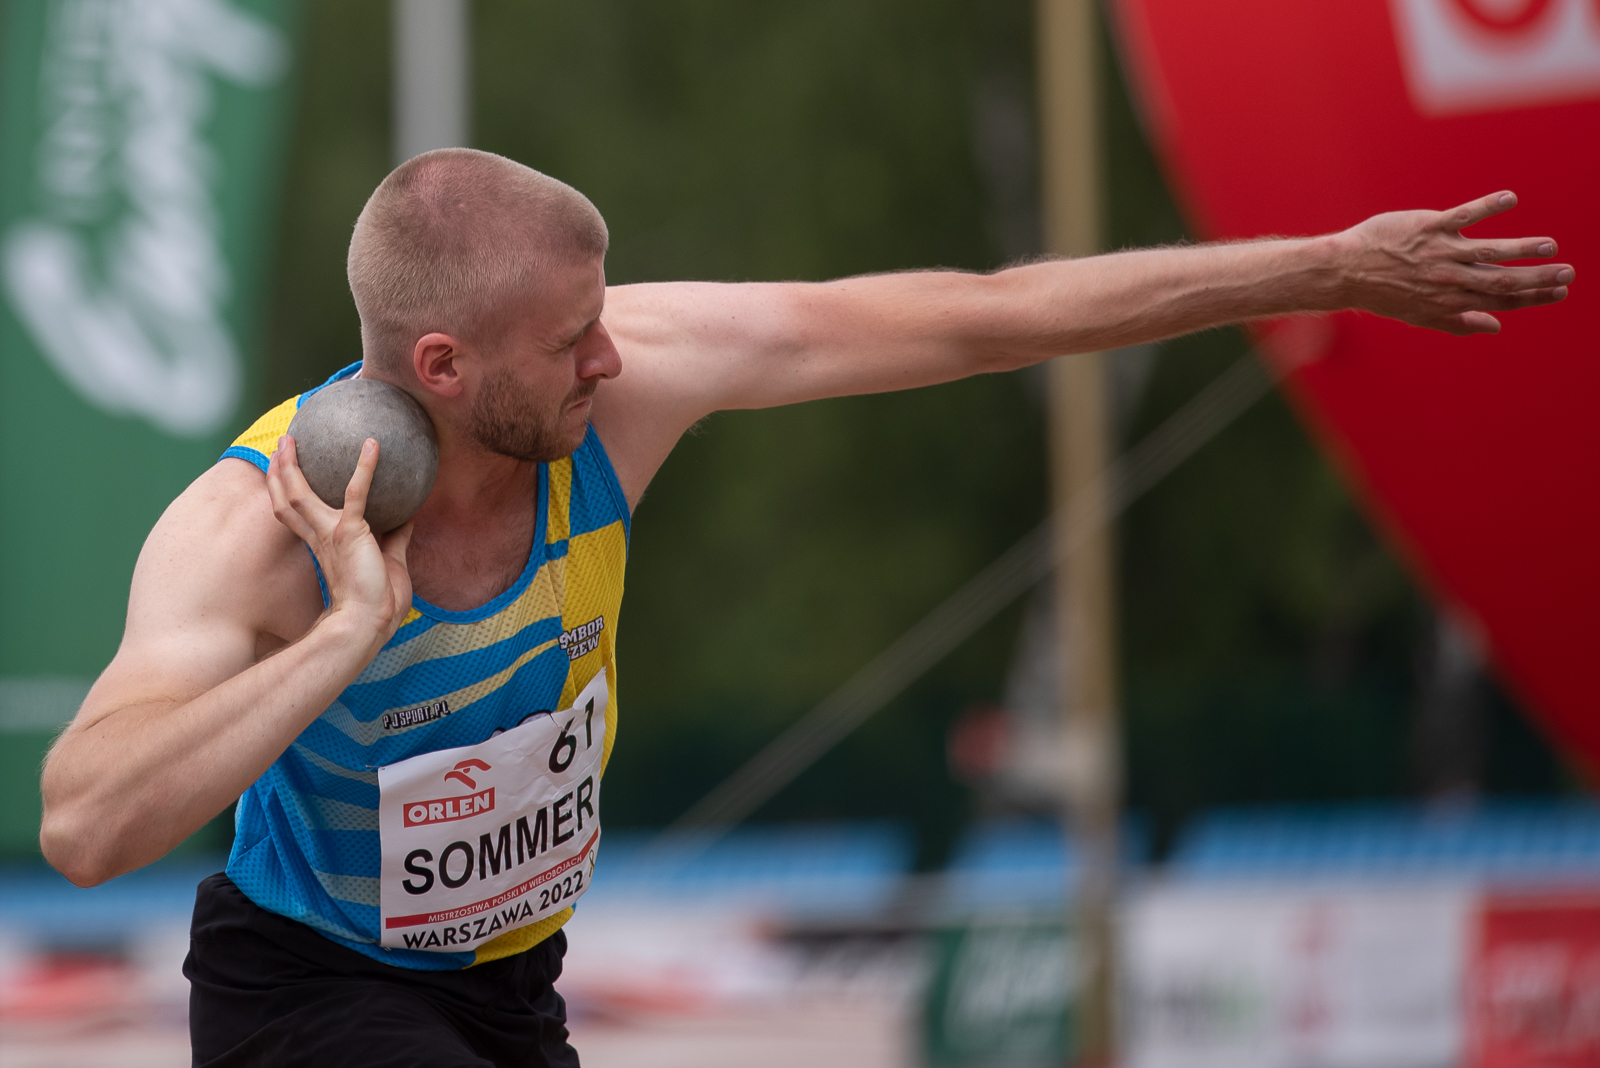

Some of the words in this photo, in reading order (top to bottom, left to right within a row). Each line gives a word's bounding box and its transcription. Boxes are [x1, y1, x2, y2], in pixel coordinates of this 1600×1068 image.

[549, 696, 594, 774] 61
[402, 775, 594, 895] SOMMER
[408, 792, 491, 824] ORLEN
[402, 899, 534, 950] WARSZAWA
[539, 870, 583, 912] 2022
[428, 902, 490, 923] MISTRZOSTWA
[492, 888, 519, 907] POLSKI
[520, 884, 528, 893] W
[528, 855, 582, 889] WIELOBOJACH
